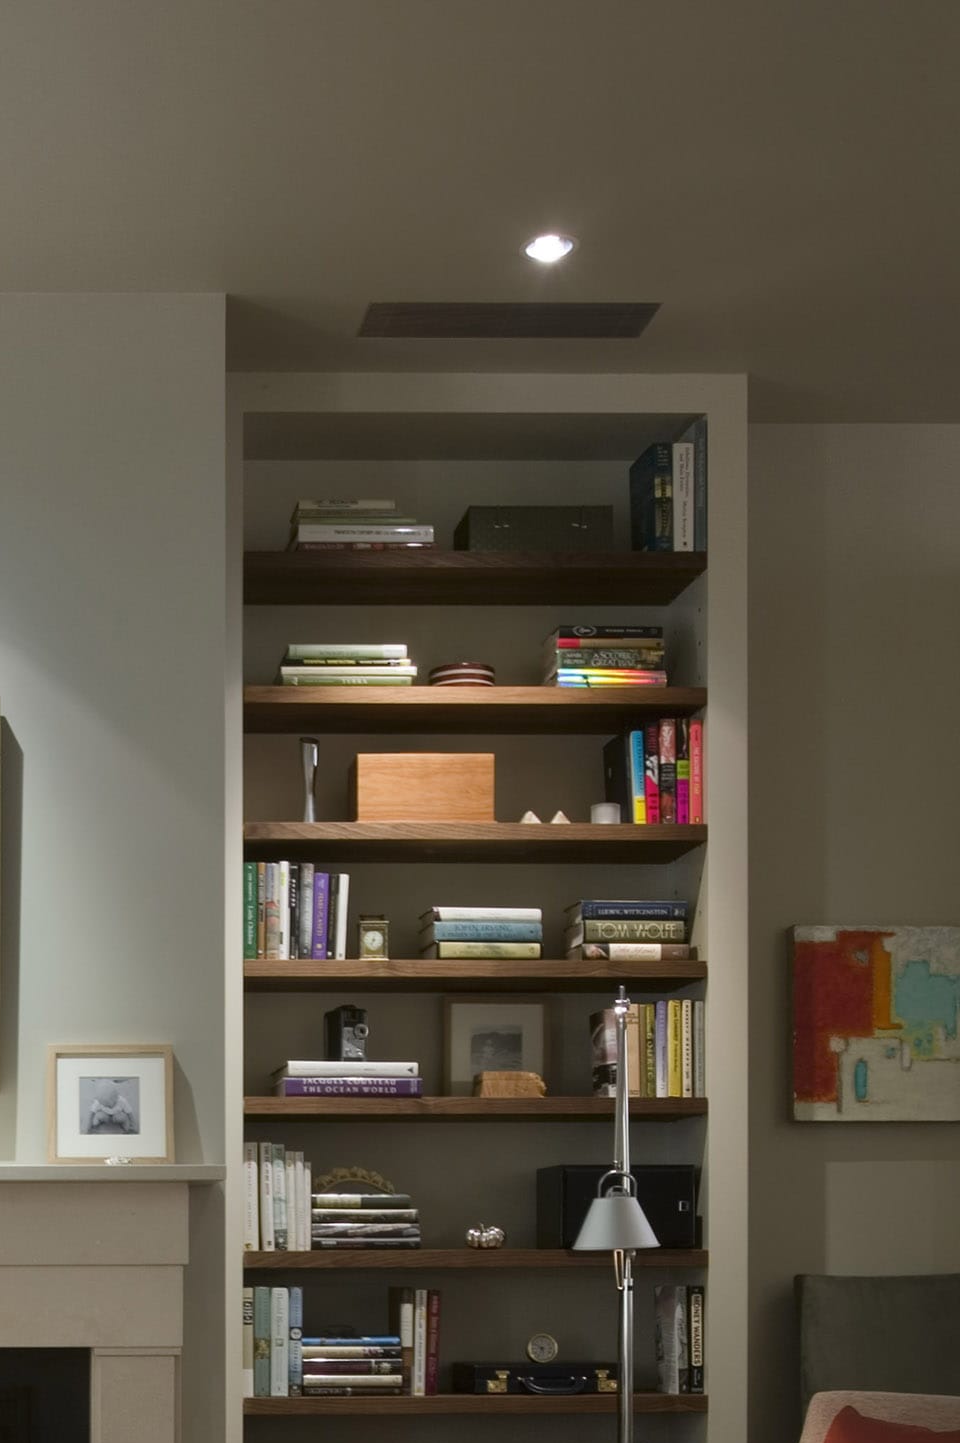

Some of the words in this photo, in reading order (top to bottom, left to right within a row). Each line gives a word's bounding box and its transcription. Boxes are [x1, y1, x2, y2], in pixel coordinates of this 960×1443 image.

[597, 923, 630, 939] TOM
[634, 923, 677, 939] WOLFE
[303, 1086, 321, 1094] THE
[324, 1086, 359, 1094] OCEAN
[363, 1086, 397, 1094] WORLD
[693, 1296, 701, 1324] MONEY
[693, 1325, 701, 1364] WANDERS
